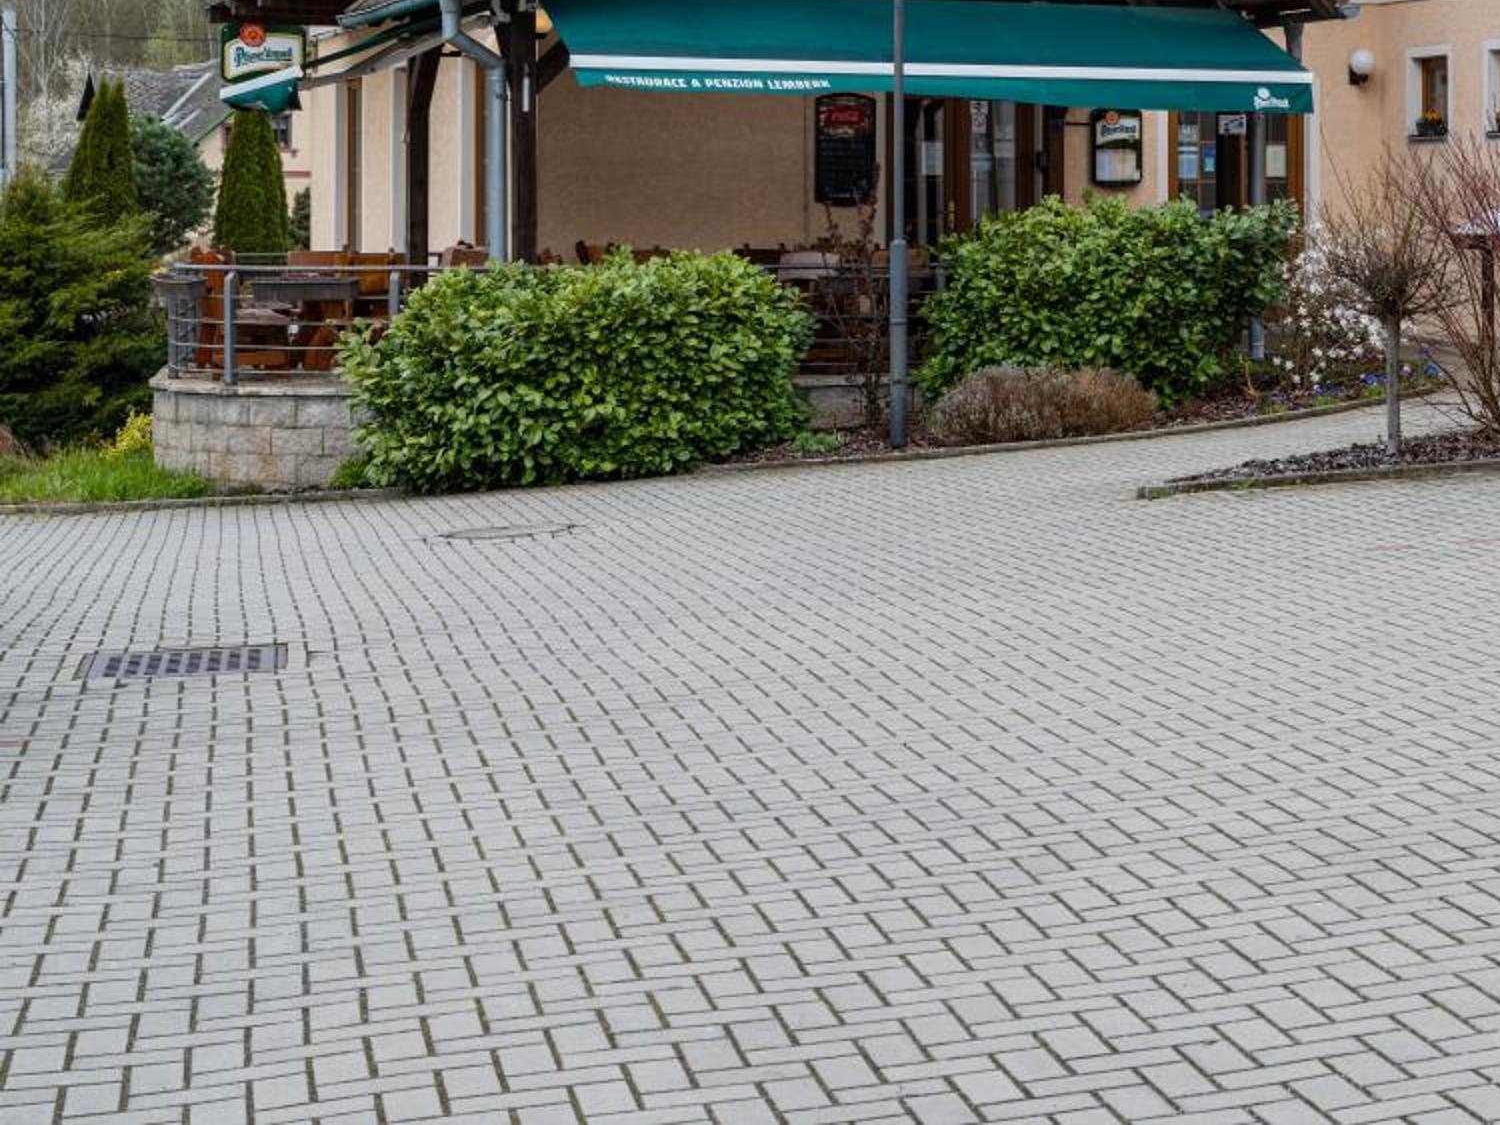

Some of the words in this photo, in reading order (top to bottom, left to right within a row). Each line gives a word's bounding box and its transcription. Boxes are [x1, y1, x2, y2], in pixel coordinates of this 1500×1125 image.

[605, 74, 687, 88] RESTAURACE
[705, 78, 763, 89] PENZION
[768, 79, 831, 90] LEMBERK
